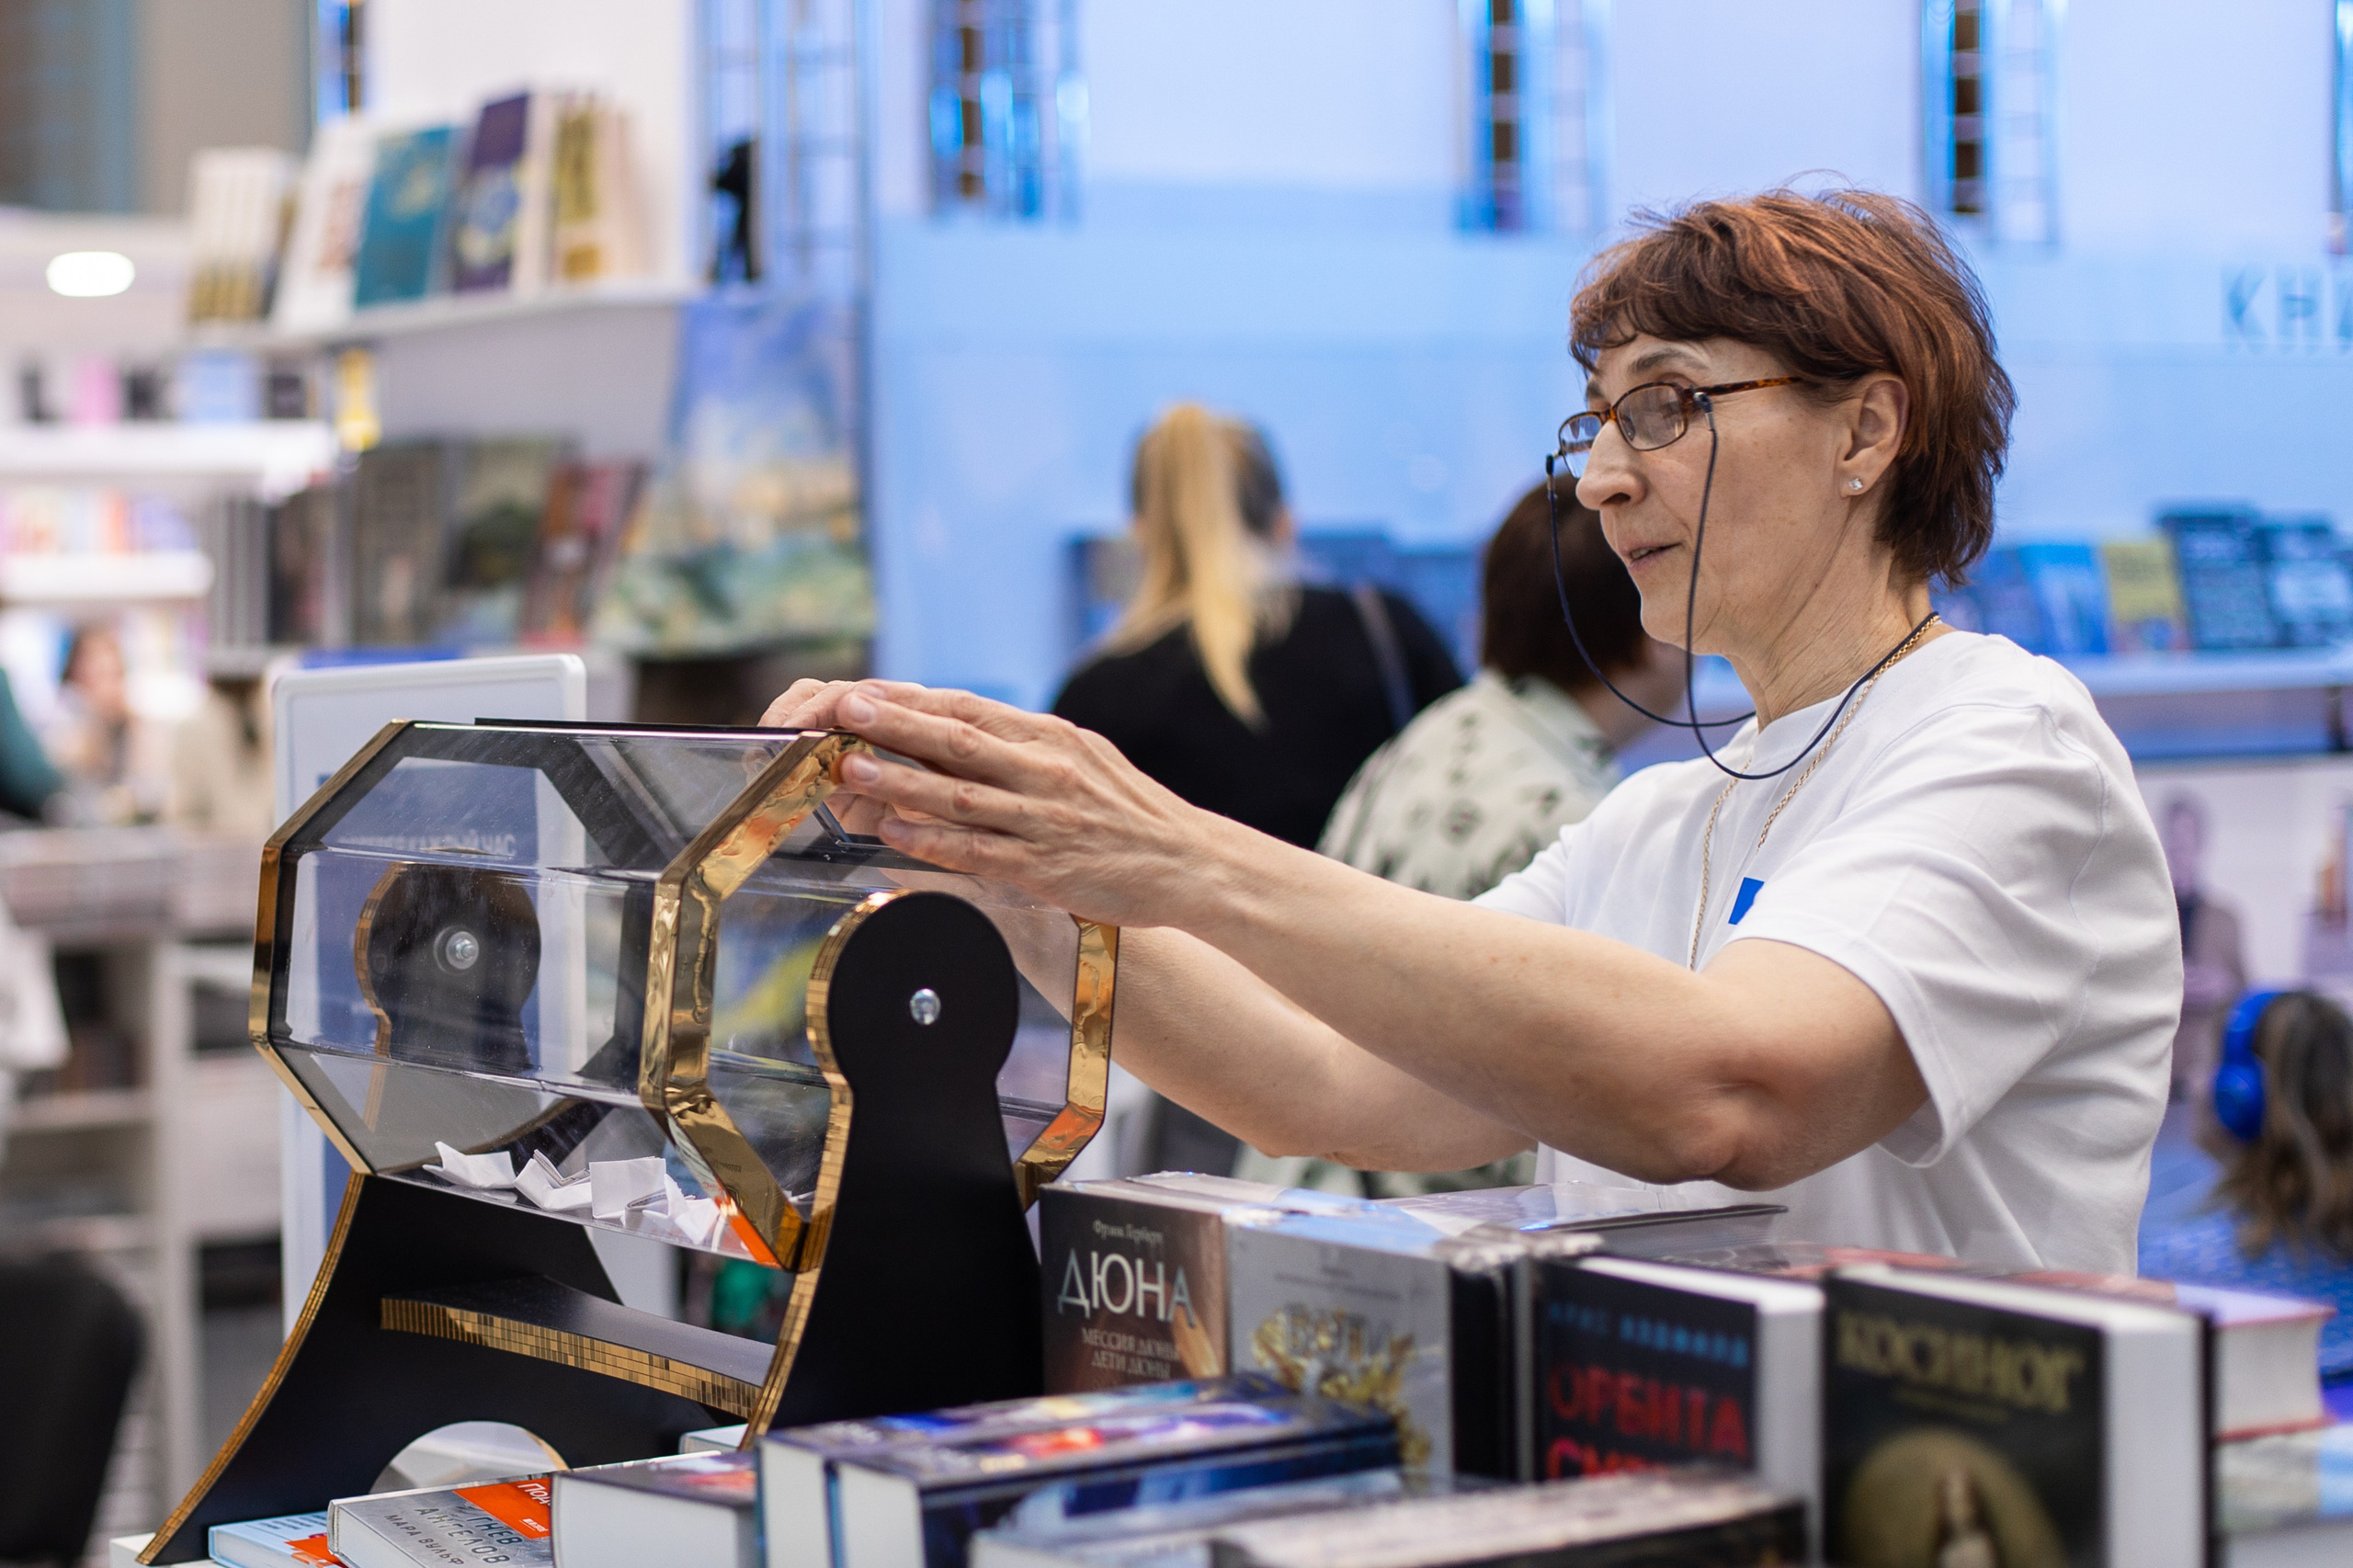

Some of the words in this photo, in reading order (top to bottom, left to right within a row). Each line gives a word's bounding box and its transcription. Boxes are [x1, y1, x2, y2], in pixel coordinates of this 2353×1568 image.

[1058, 1247, 1196, 1329] ДЮНА
[1091, 1349, 1127, 1371] ДЕТИ
[384, 1515, 422, 1537] МАРА
[418, 1538, 465, 1565] ВУЛЬФ
[415, 1507, 511, 1563] АНГЕЛОВ
[467, 1517, 523, 1545] ГНЕВ
